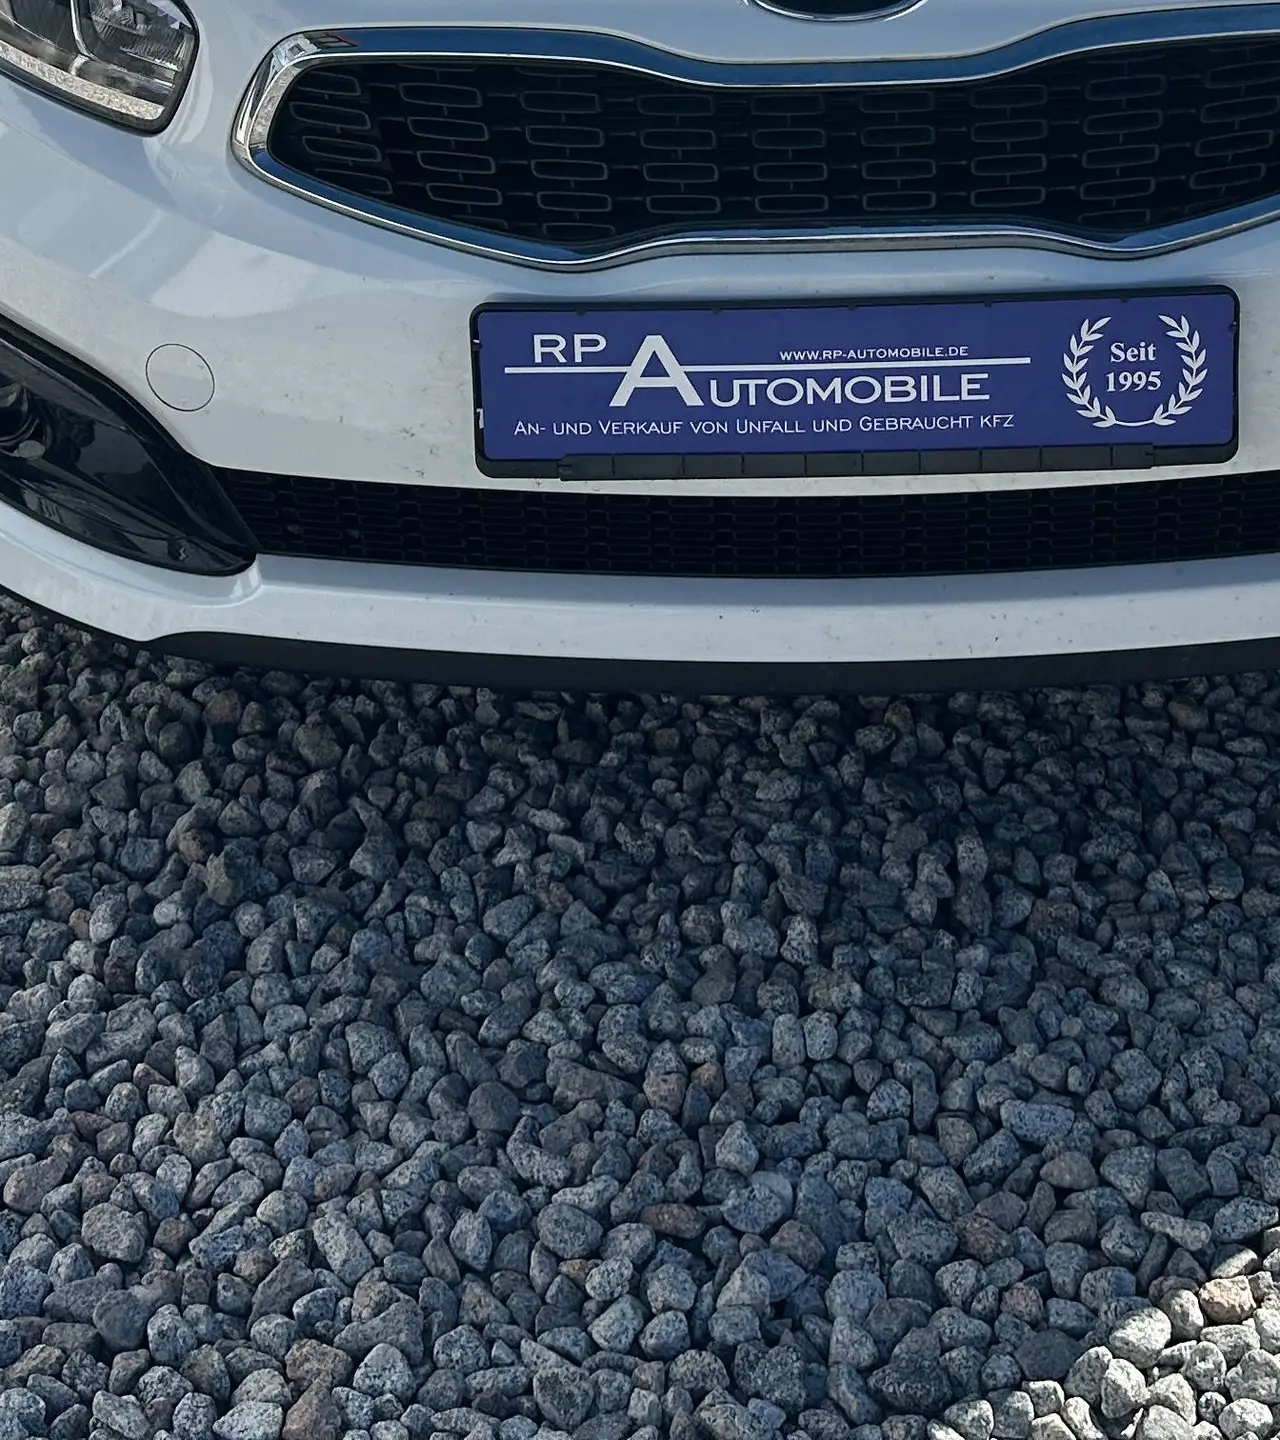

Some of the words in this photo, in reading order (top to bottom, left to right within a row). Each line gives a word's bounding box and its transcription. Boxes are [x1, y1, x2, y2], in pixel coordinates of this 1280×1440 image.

[779, 346, 969, 361] WWW.RP-AUTOMOBILE.DE
[1110, 342, 1157, 363] Seit
[533, 333, 607, 363] RP
[609, 334, 990, 408] AUTOMOBILE
[1106, 371, 1162, 392] 1995
[514, 420, 546, 435] AN-
[553, 421, 592, 435] UND
[598, 420, 683, 435] VERKAUF
[689, 421, 728, 435] VON
[736, 418, 806, 434] UNFALL
[813, 418, 852, 433] UND
[859, 415, 973, 431] GEBRAUCHT
[980, 414, 1014, 429] KFZ
